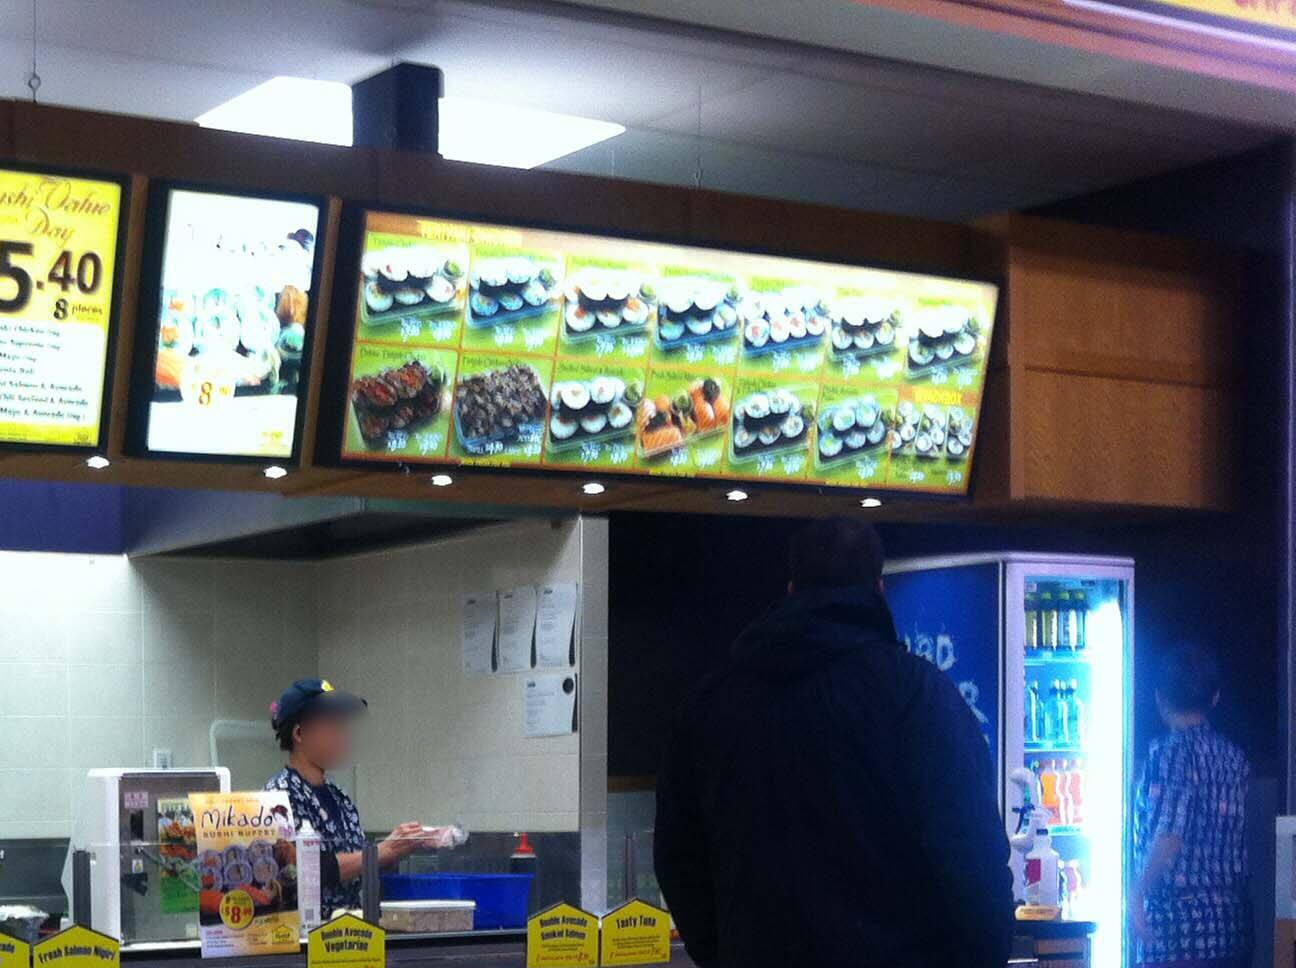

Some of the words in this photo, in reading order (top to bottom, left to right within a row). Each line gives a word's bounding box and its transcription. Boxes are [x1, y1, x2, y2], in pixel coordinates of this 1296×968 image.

[25, 207, 73, 247] Day
[54, 299, 69, 320] 8
[201, 805, 273, 830] Mikado
